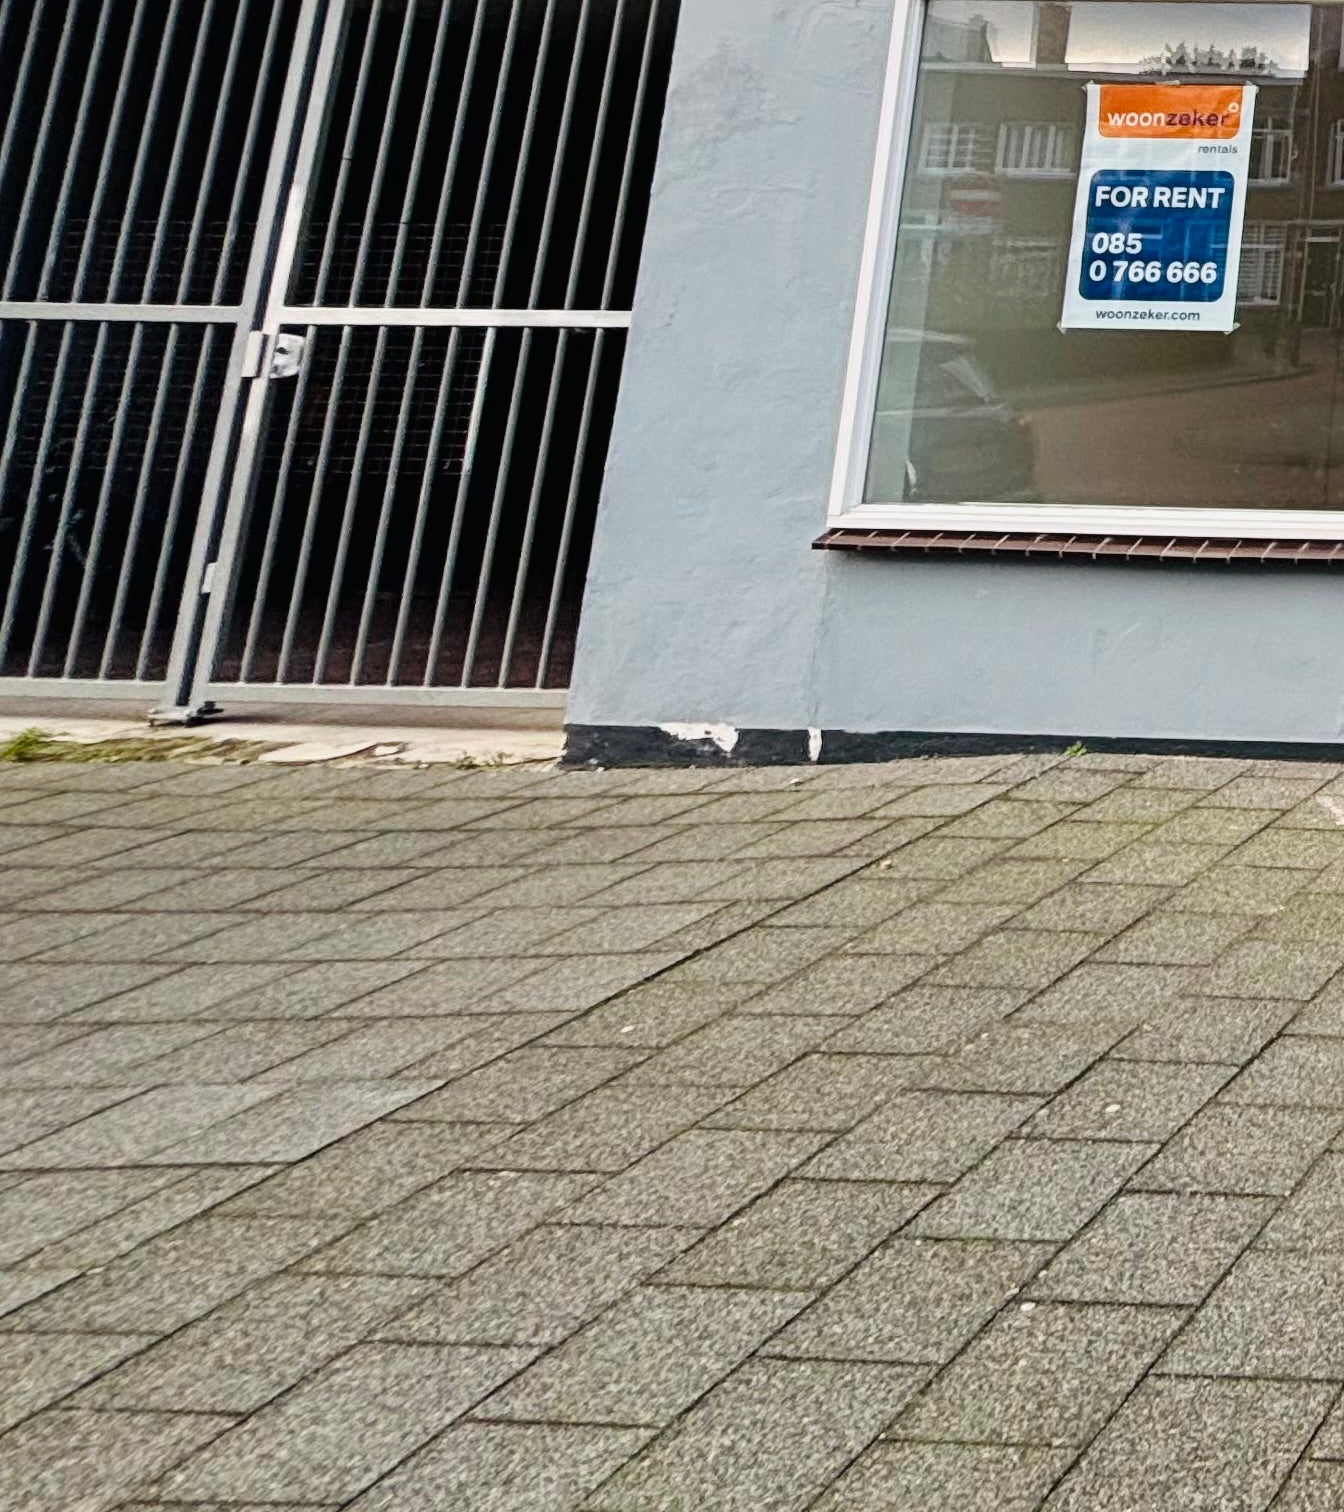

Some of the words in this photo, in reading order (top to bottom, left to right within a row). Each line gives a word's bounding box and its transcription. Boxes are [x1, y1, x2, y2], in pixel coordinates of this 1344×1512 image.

[1107, 108, 1229, 128] woonzeker
[1198, 144, 1238, 154] rentals
[1095, 186, 1148, 208] FOR
[1153, 187, 1226, 209] RENT
[1091, 232, 1143, 255] 085
[1089, 260, 1107, 282] 0
[1113, 260, 1161, 283] 766
[1166, 261, 1218, 284] 666
[1095, 308, 1201, 321] woonzeker.com
